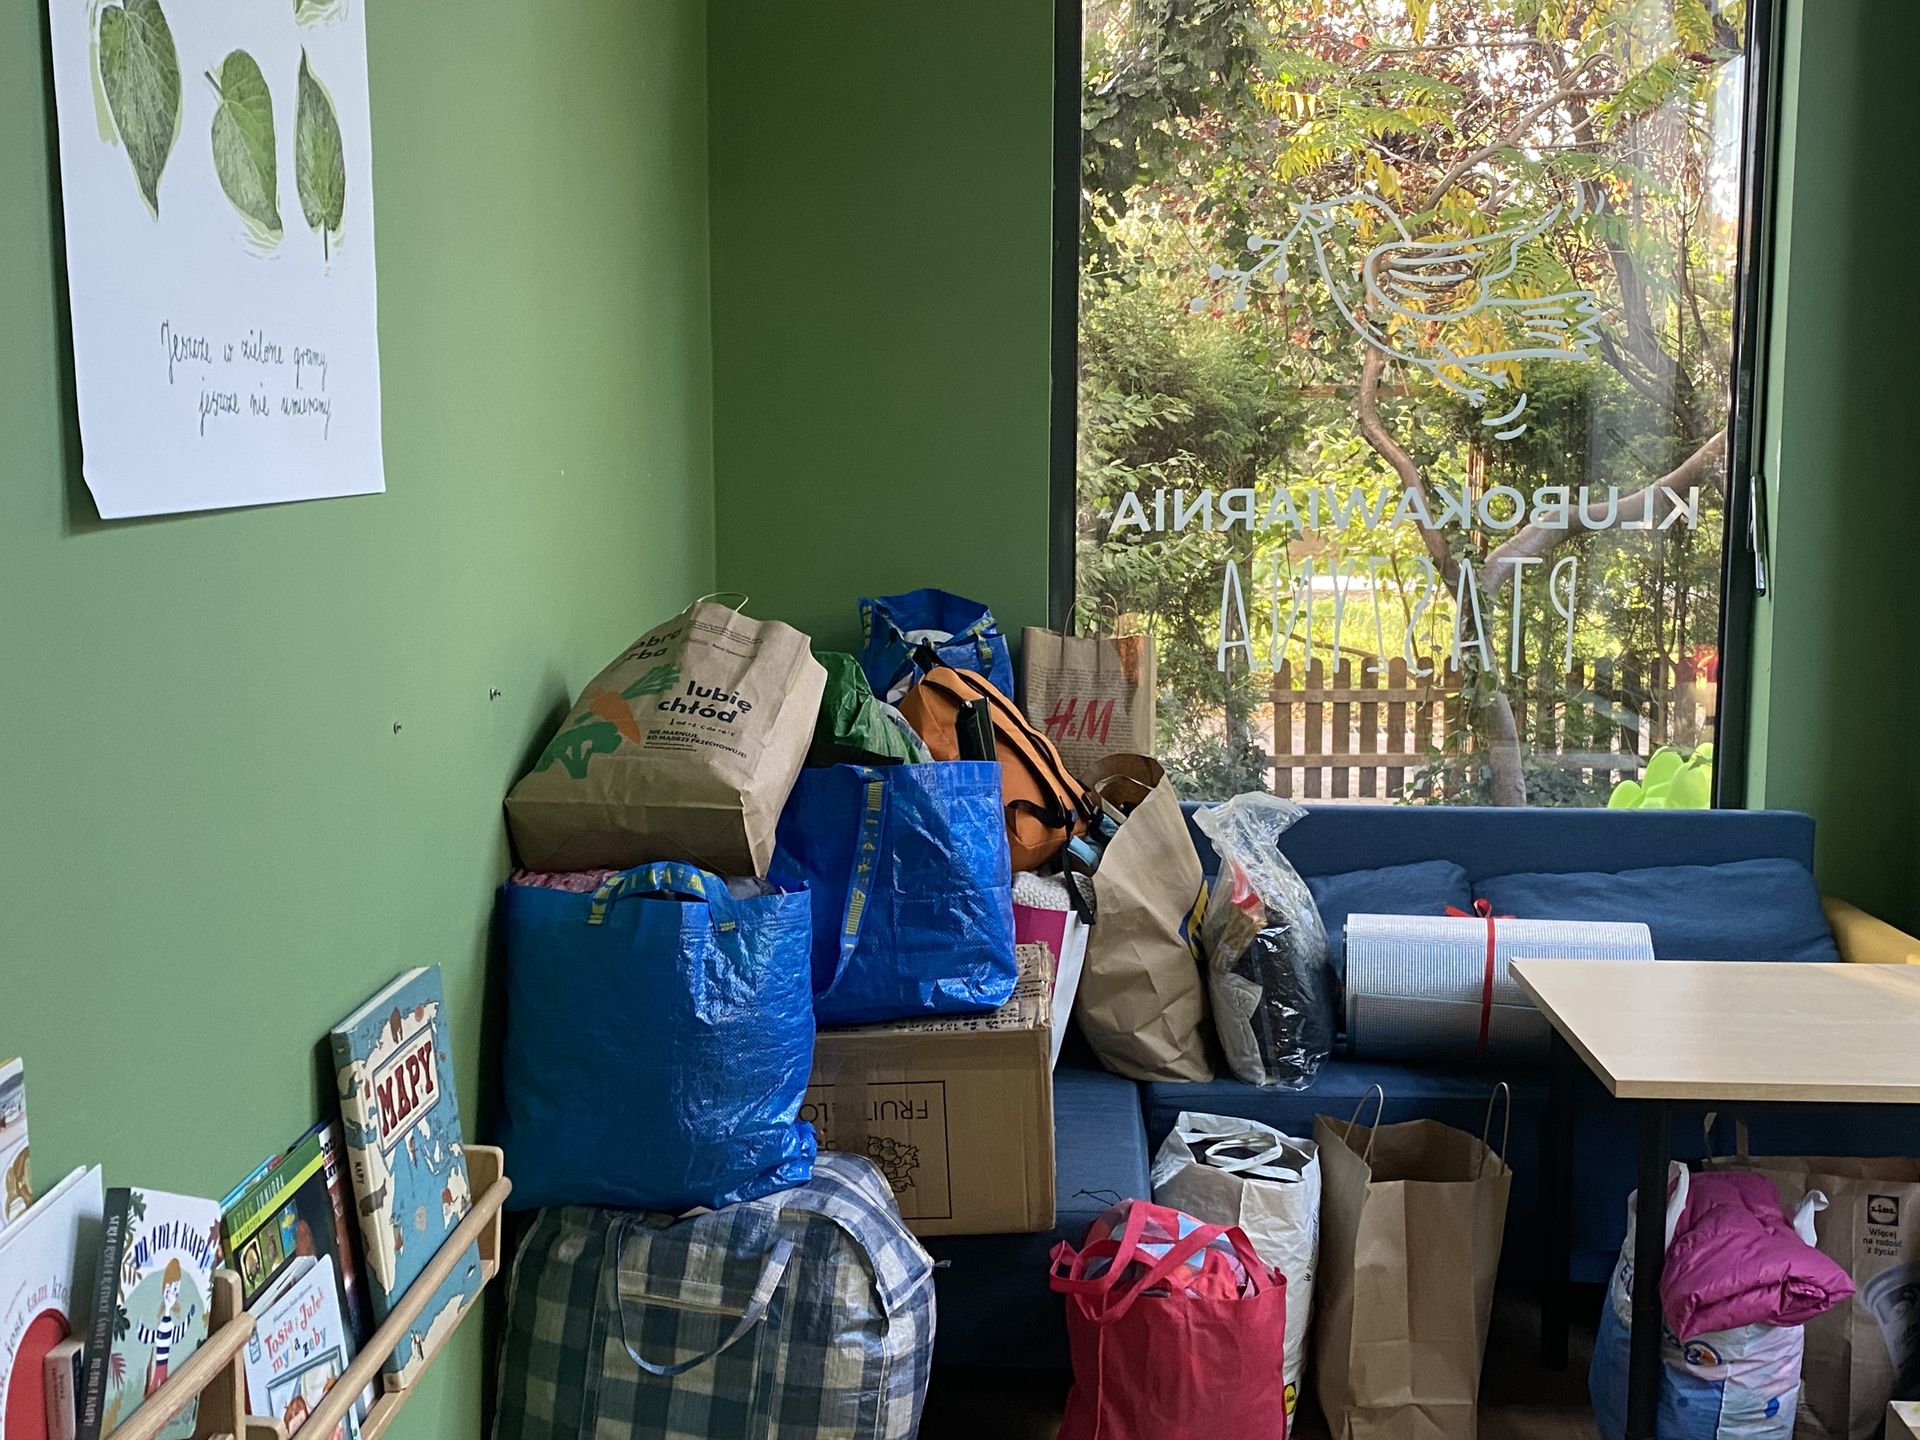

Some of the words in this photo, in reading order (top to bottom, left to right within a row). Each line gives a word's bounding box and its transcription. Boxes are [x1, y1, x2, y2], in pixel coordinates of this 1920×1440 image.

[250, 382, 270, 417] nie
[657, 697, 738, 724] chłód
[686, 680, 753, 714] lubię
[1043, 695, 1117, 746] H&M
[377, 1040, 434, 1138] MAPY
[354, 1161, 365, 1185] MAPY
[134, 1219, 179, 1270] MAMA
[1863, 1237, 1873, 1245] na
[1875, 1239, 1903, 1248] radość
[1869, 1228, 1897, 1240] Więcej
[27, 1284, 48, 1313] tam
[264, 1319, 293, 1359] Tosia
[299, 1286, 324, 1330] Julek
